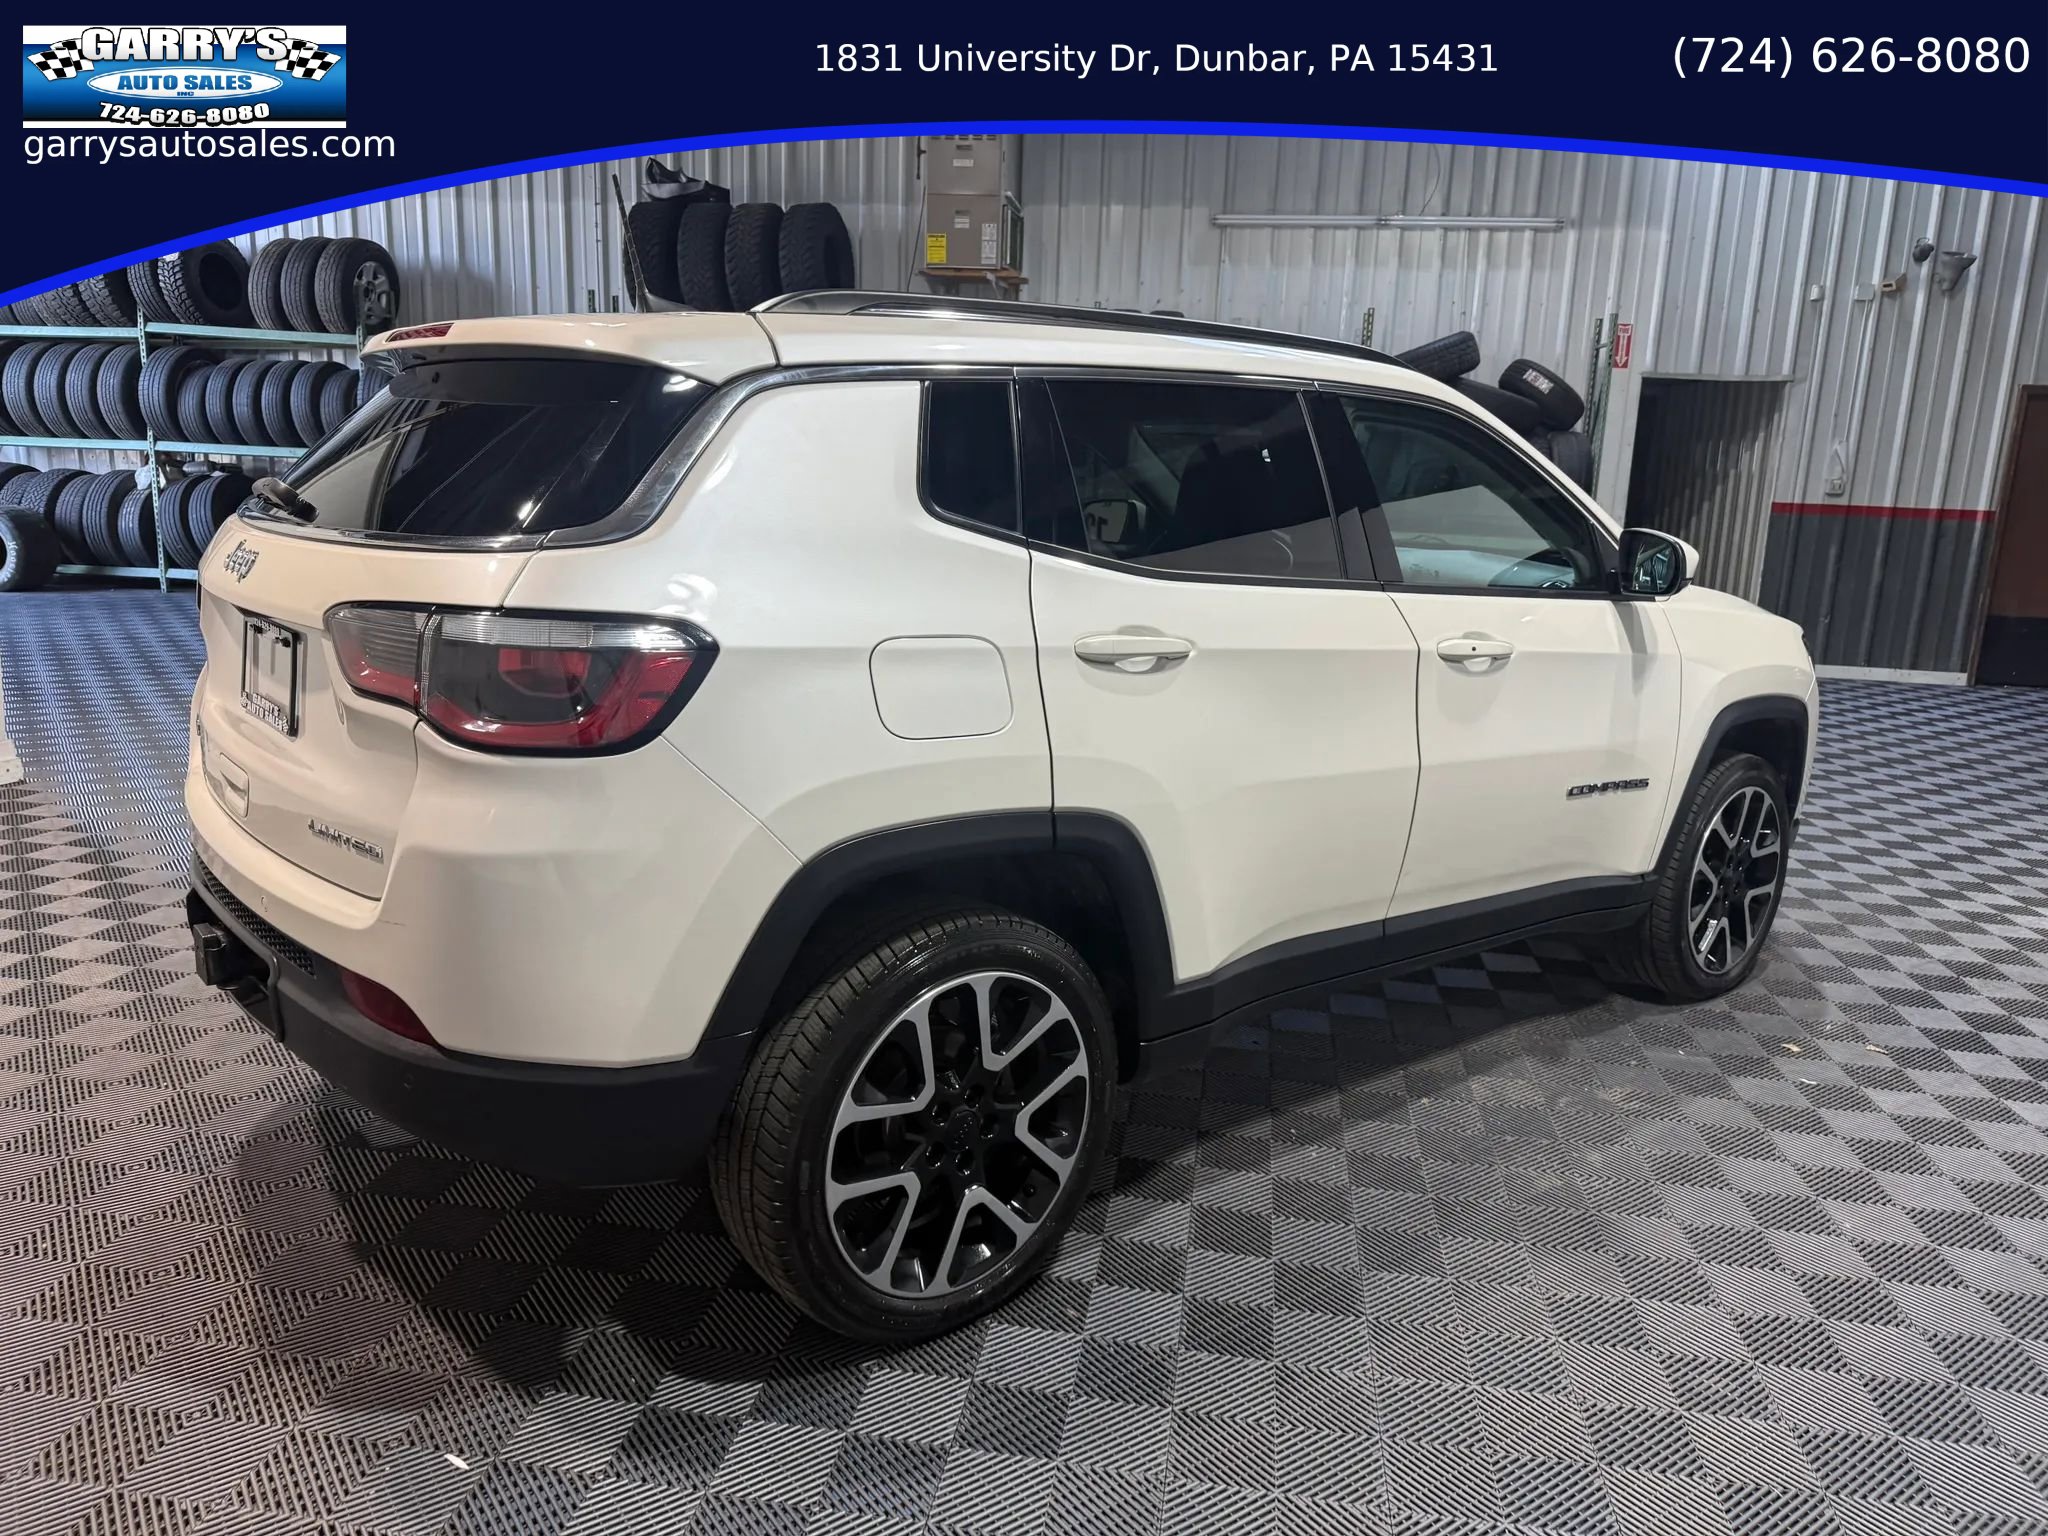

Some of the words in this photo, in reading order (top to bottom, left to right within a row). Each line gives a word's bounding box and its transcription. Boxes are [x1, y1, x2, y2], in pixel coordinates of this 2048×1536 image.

[223, 539, 259, 584] Jeep
[246, 700, 265, 719] AUTO
[1567, 777, 1650, 797] COMPASS
[307, 819, 384, 859] LIMITED
